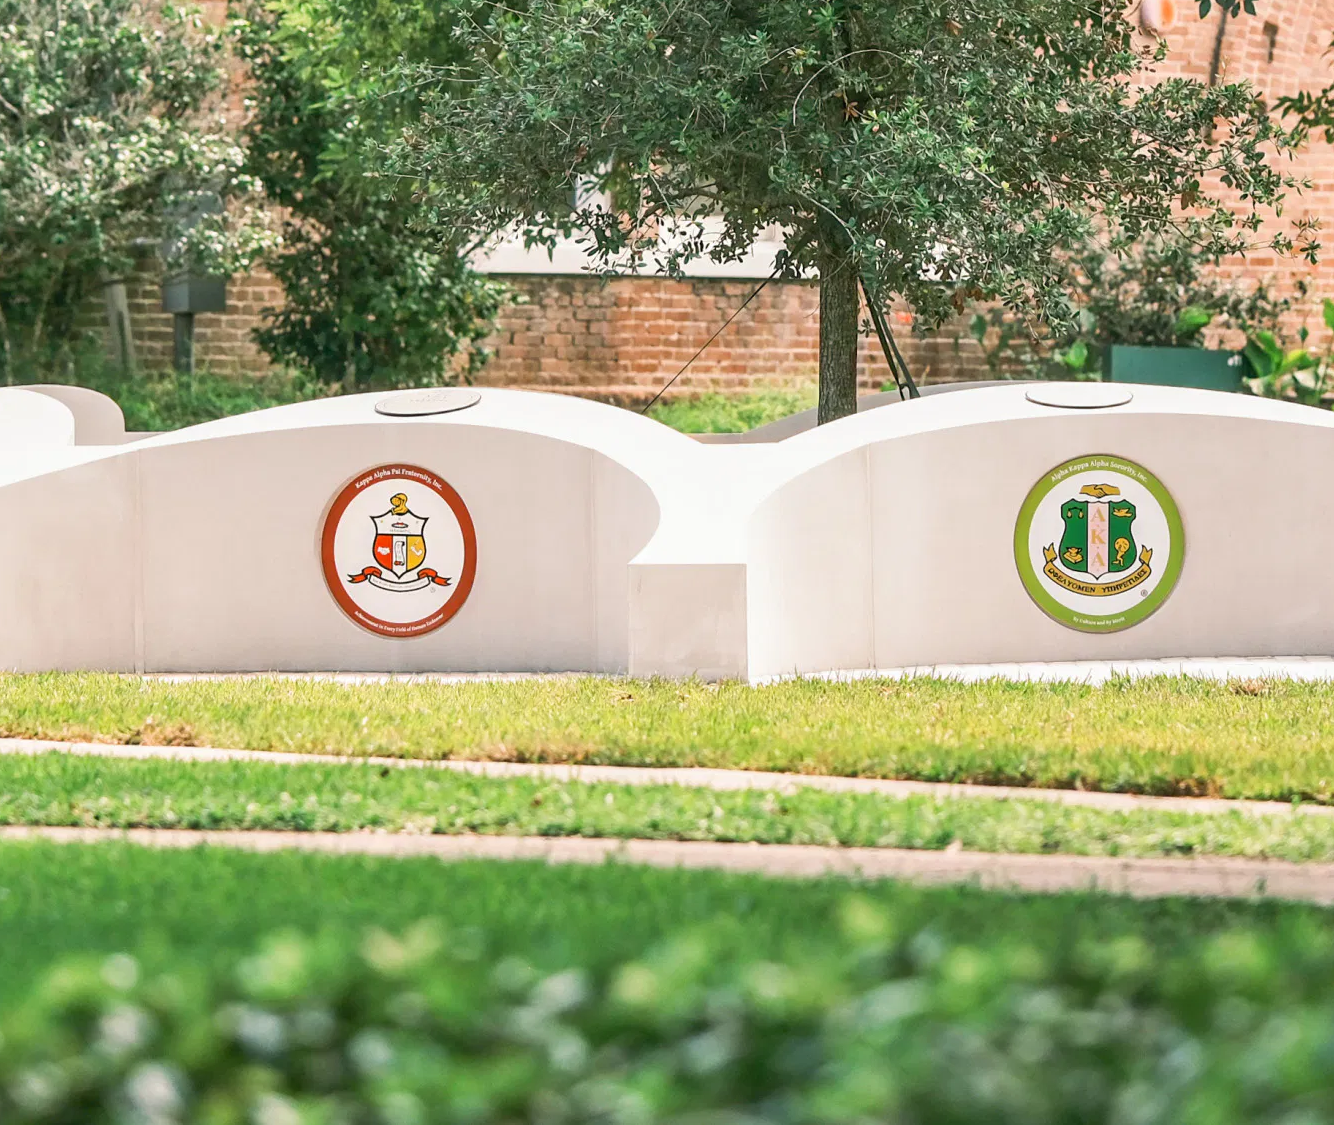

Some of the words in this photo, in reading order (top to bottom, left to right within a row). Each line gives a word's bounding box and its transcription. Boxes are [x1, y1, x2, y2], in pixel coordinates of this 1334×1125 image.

[355, 475, 373, 489] Kappa
[374, 469, 391, 479] Alpha
[401, 469, 432, 483] Fraternity,
[432, 479, 443, 491] Inc.
[1051, 468, 1069, 482] Alpha
[1069, 462, 1089, 472] Kappa
[1090, 460, 1109, 468] Alpha
[1110, 461, 1137, 477] Sorority,
[1137, 472, 1148, 483] Inc.
